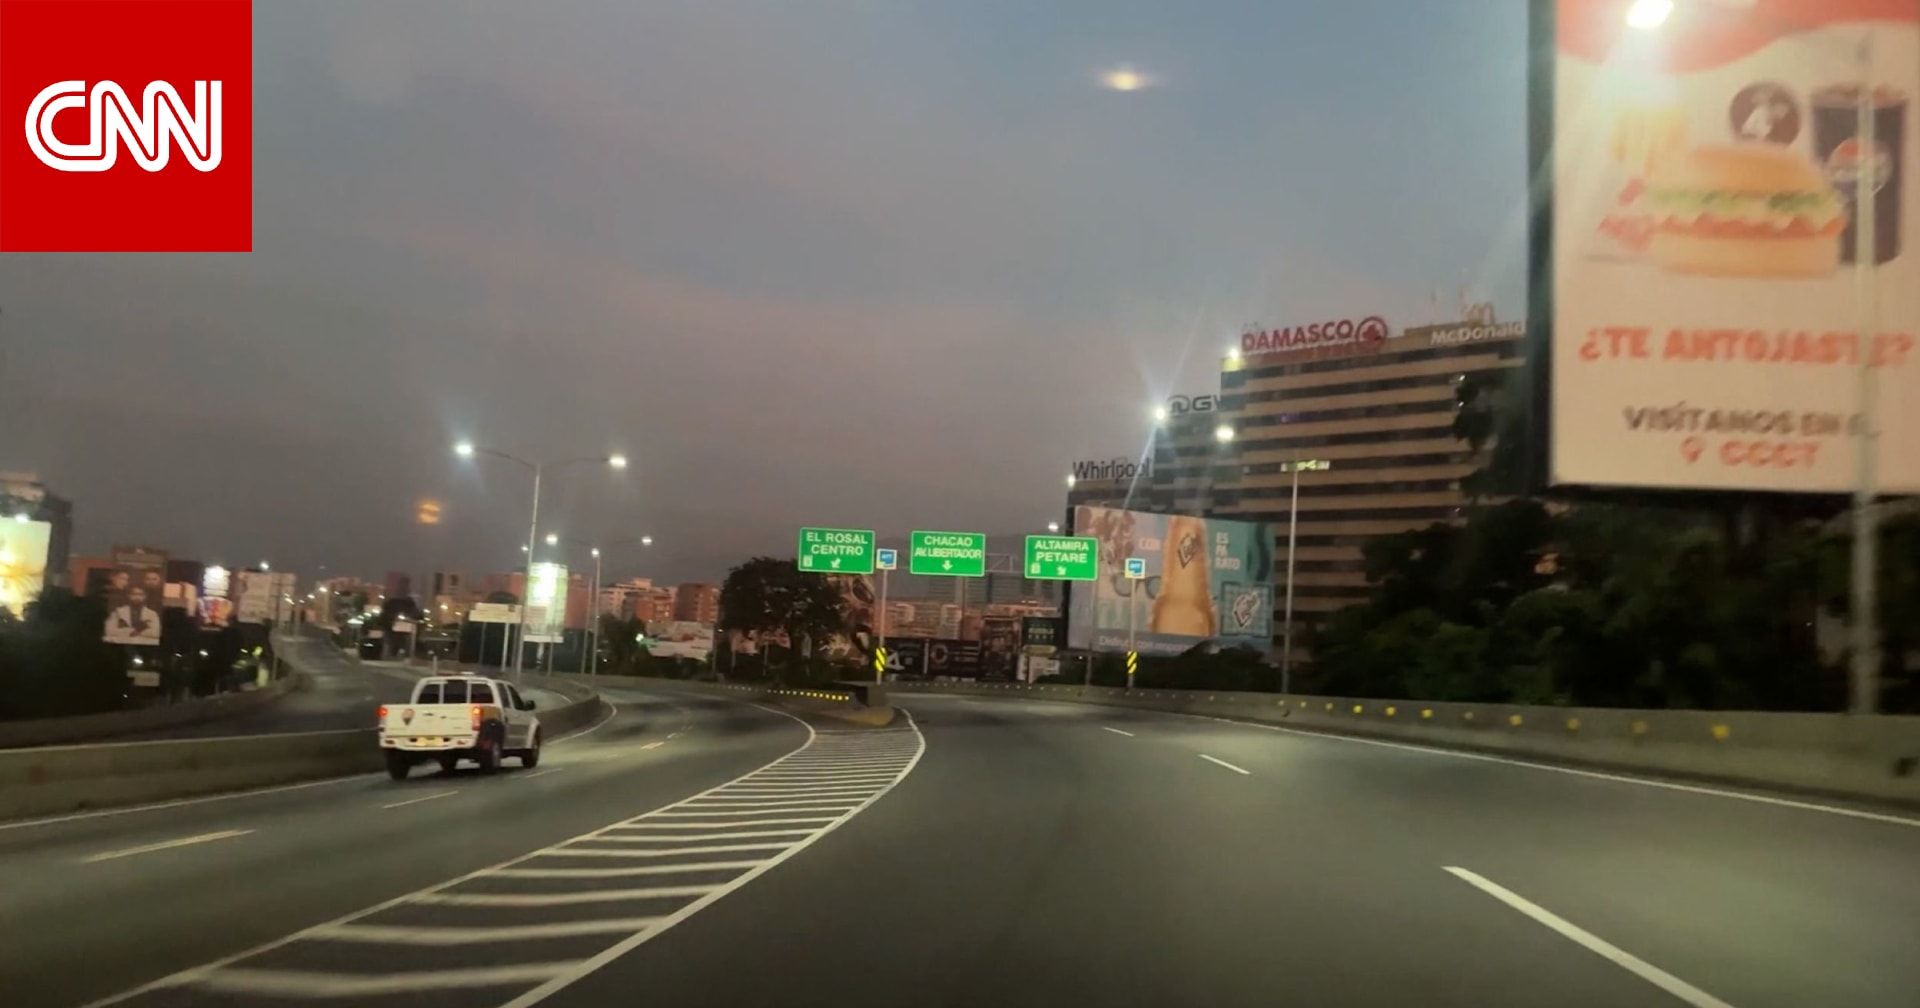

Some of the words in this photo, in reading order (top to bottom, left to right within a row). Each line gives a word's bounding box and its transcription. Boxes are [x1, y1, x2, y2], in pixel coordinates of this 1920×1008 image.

[1241, 319, 1354, 351] DAMASCO
[1579, 327, 1652, 361] ¿TE
[1622, 401, 1795, 435] VISÍTANOS
[1073, 457, 1151, 484] Whirlpool
[806, 532, 821, 542] EL
[826, 533, 868, 544] ROSAL
[924, 536, 973, 547] CHACAO
[811, 544, 864, 556] CENTRO
[1034, 540, 1089, 552] ALTAMIRA
[928, 548, 982, 559] LIBERTADOR
[1035, 551, 1088, 563] PETARE
